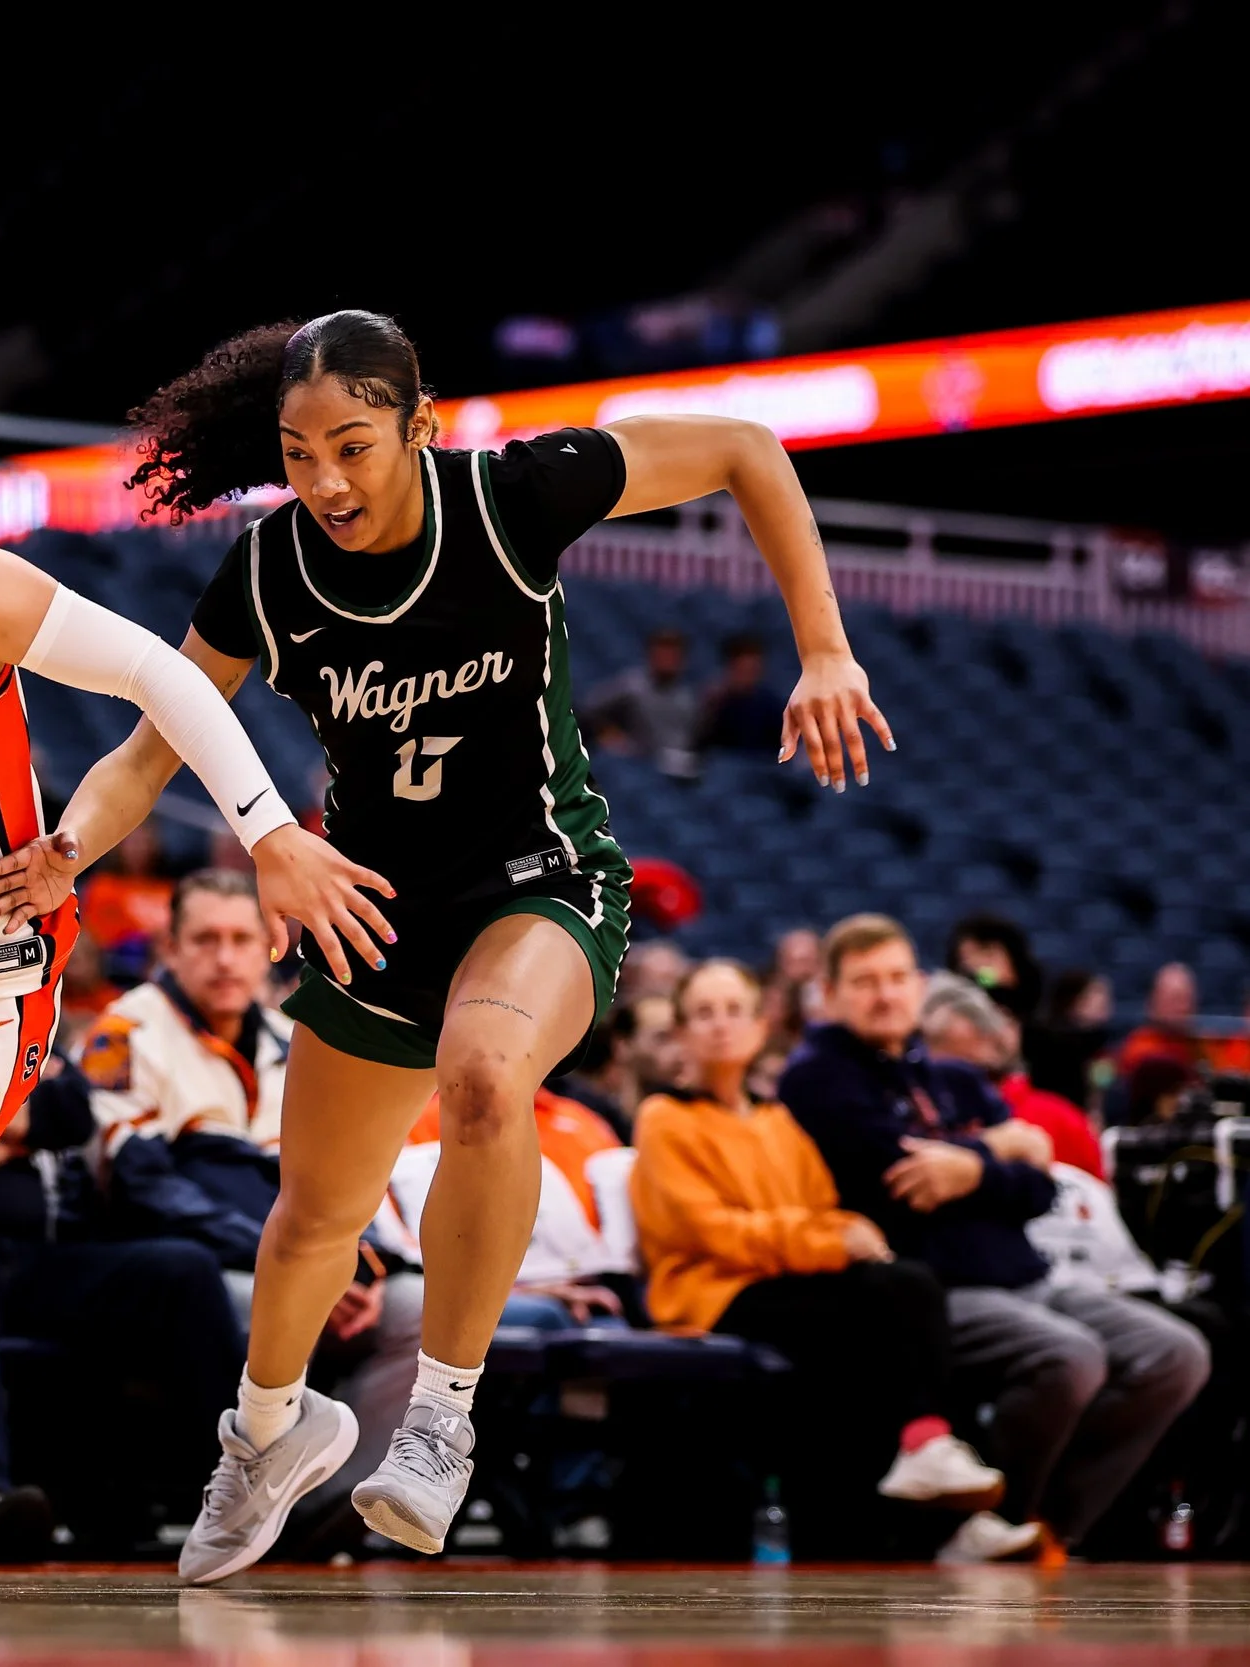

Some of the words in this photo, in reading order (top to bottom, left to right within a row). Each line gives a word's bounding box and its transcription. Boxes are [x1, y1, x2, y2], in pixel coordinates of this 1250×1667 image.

[319, 651, 514, 733] Wagner
[547, 855, 560, 868] M
[25, 947, 36, 960] M
[23, 1043, 40, 1082] S
